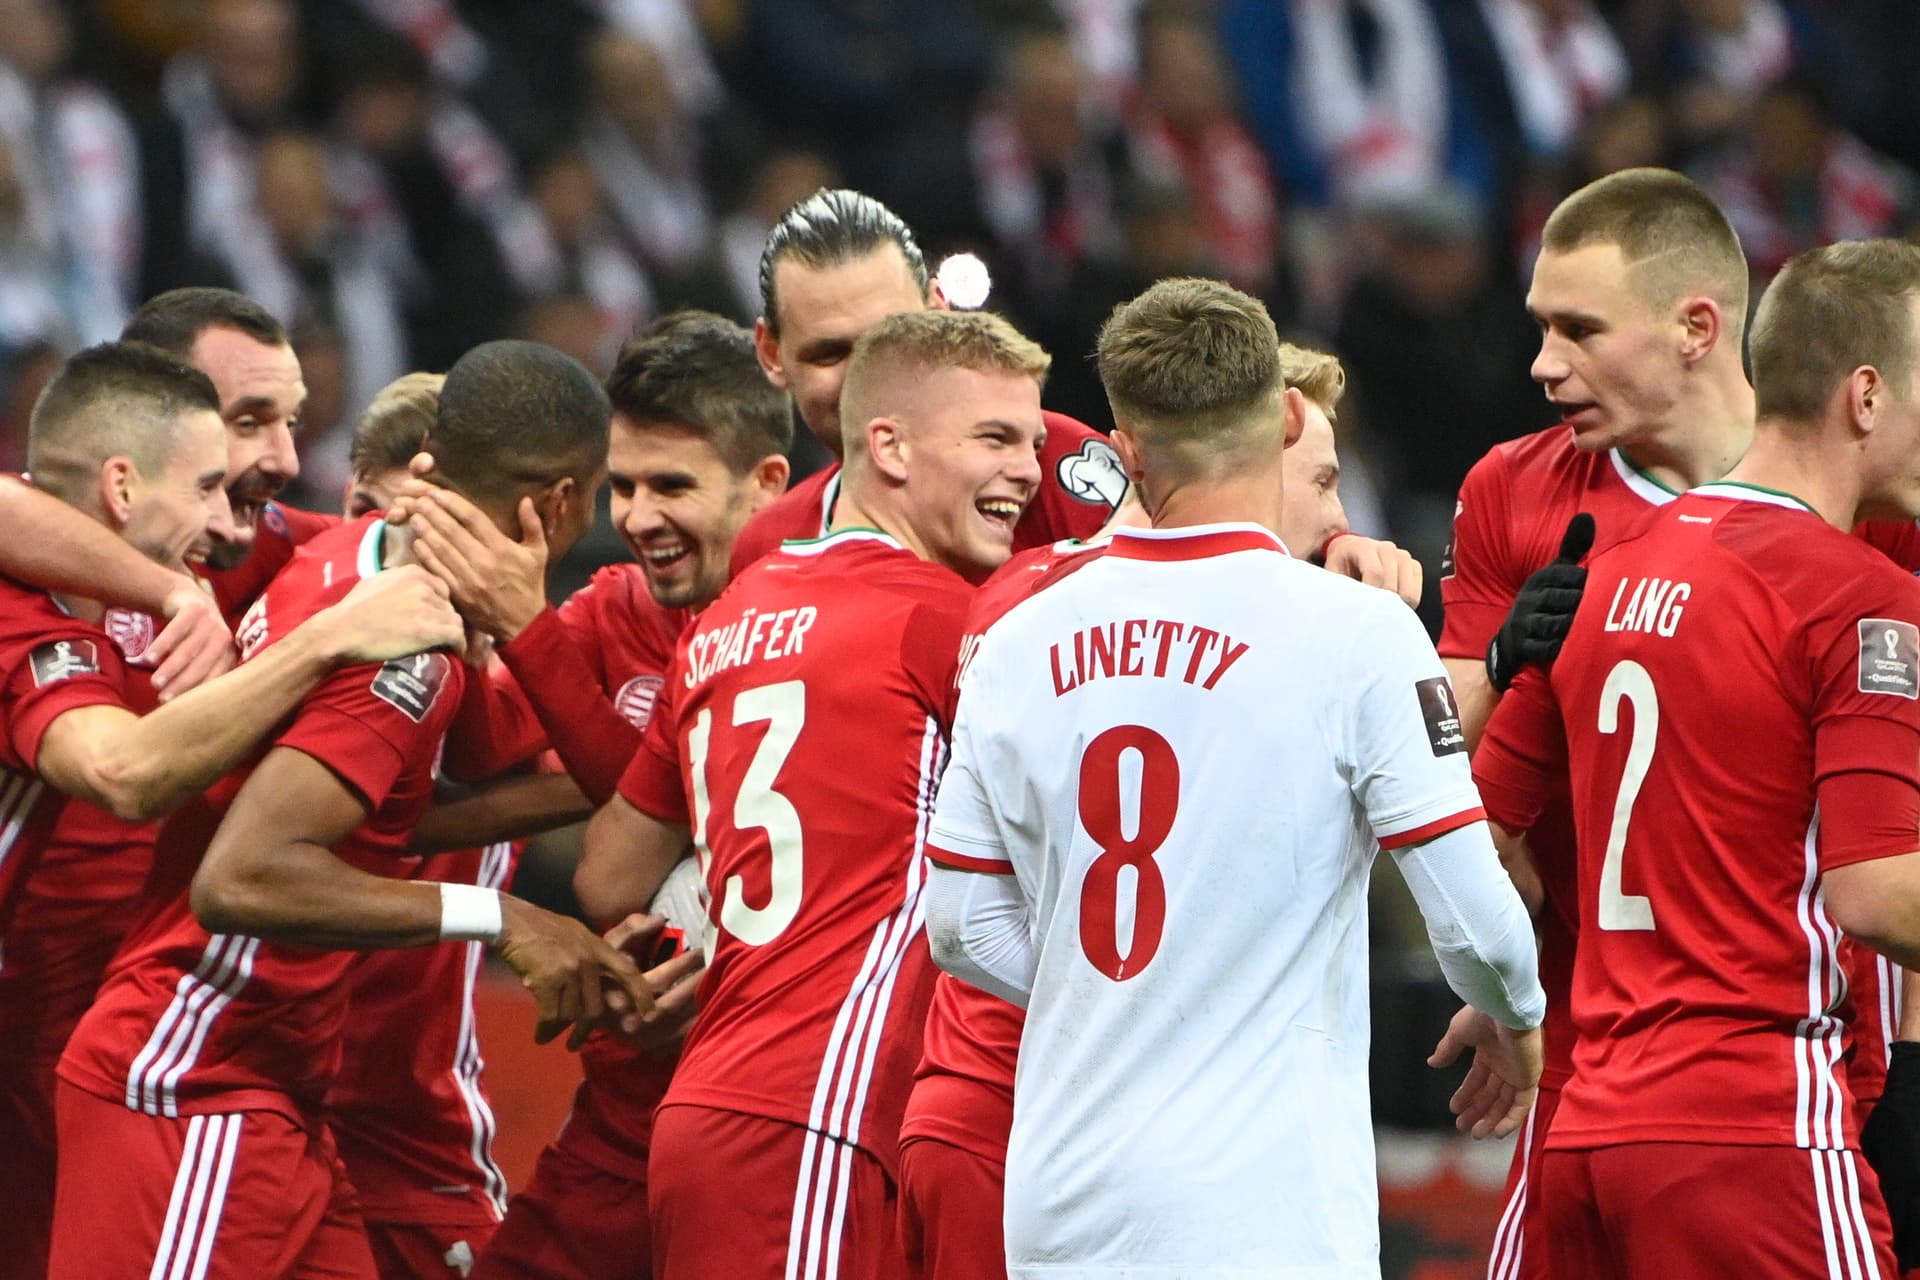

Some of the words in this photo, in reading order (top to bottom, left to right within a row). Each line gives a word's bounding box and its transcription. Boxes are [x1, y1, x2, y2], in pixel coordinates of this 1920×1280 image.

[685, 606, 817, 689] SCHÄFER
[1050, 619, 1250, 698] LINETTY
[1604, 577, 1691, 638] LANG
[689, 679, 805, 968] 13
[1079, 724, 1180, 982] 8
[1598, 660, 1659, 930] 2
